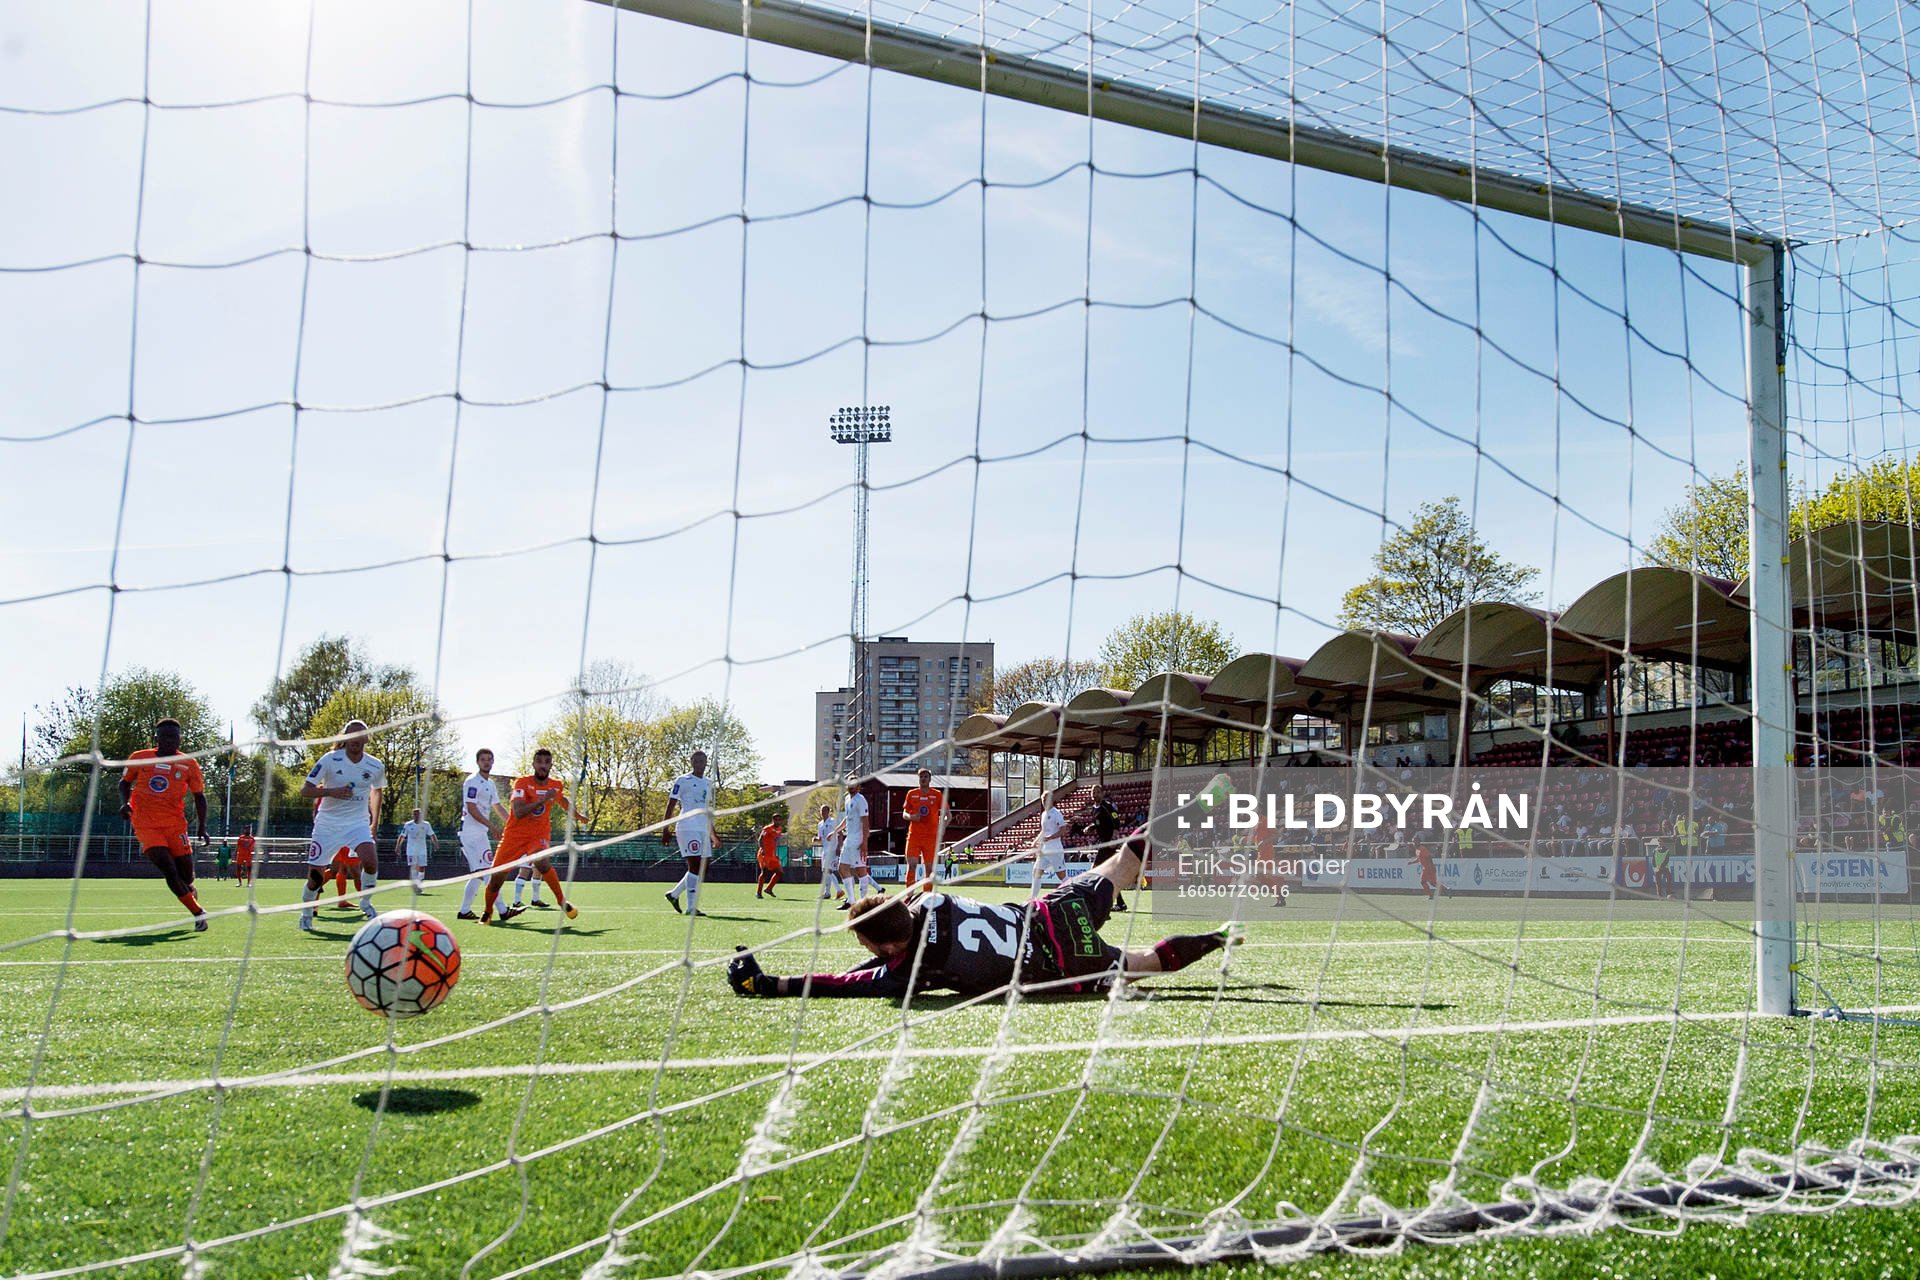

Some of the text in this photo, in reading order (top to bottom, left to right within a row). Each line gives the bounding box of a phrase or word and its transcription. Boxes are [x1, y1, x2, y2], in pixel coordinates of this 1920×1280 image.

[1367, 867, 1403, 880] BERNER
[1484, 867, 1529, 878] AFC Academ
[1826, 859, 1889, 877] STENA
[1076, 915, 1094, 955] akea
